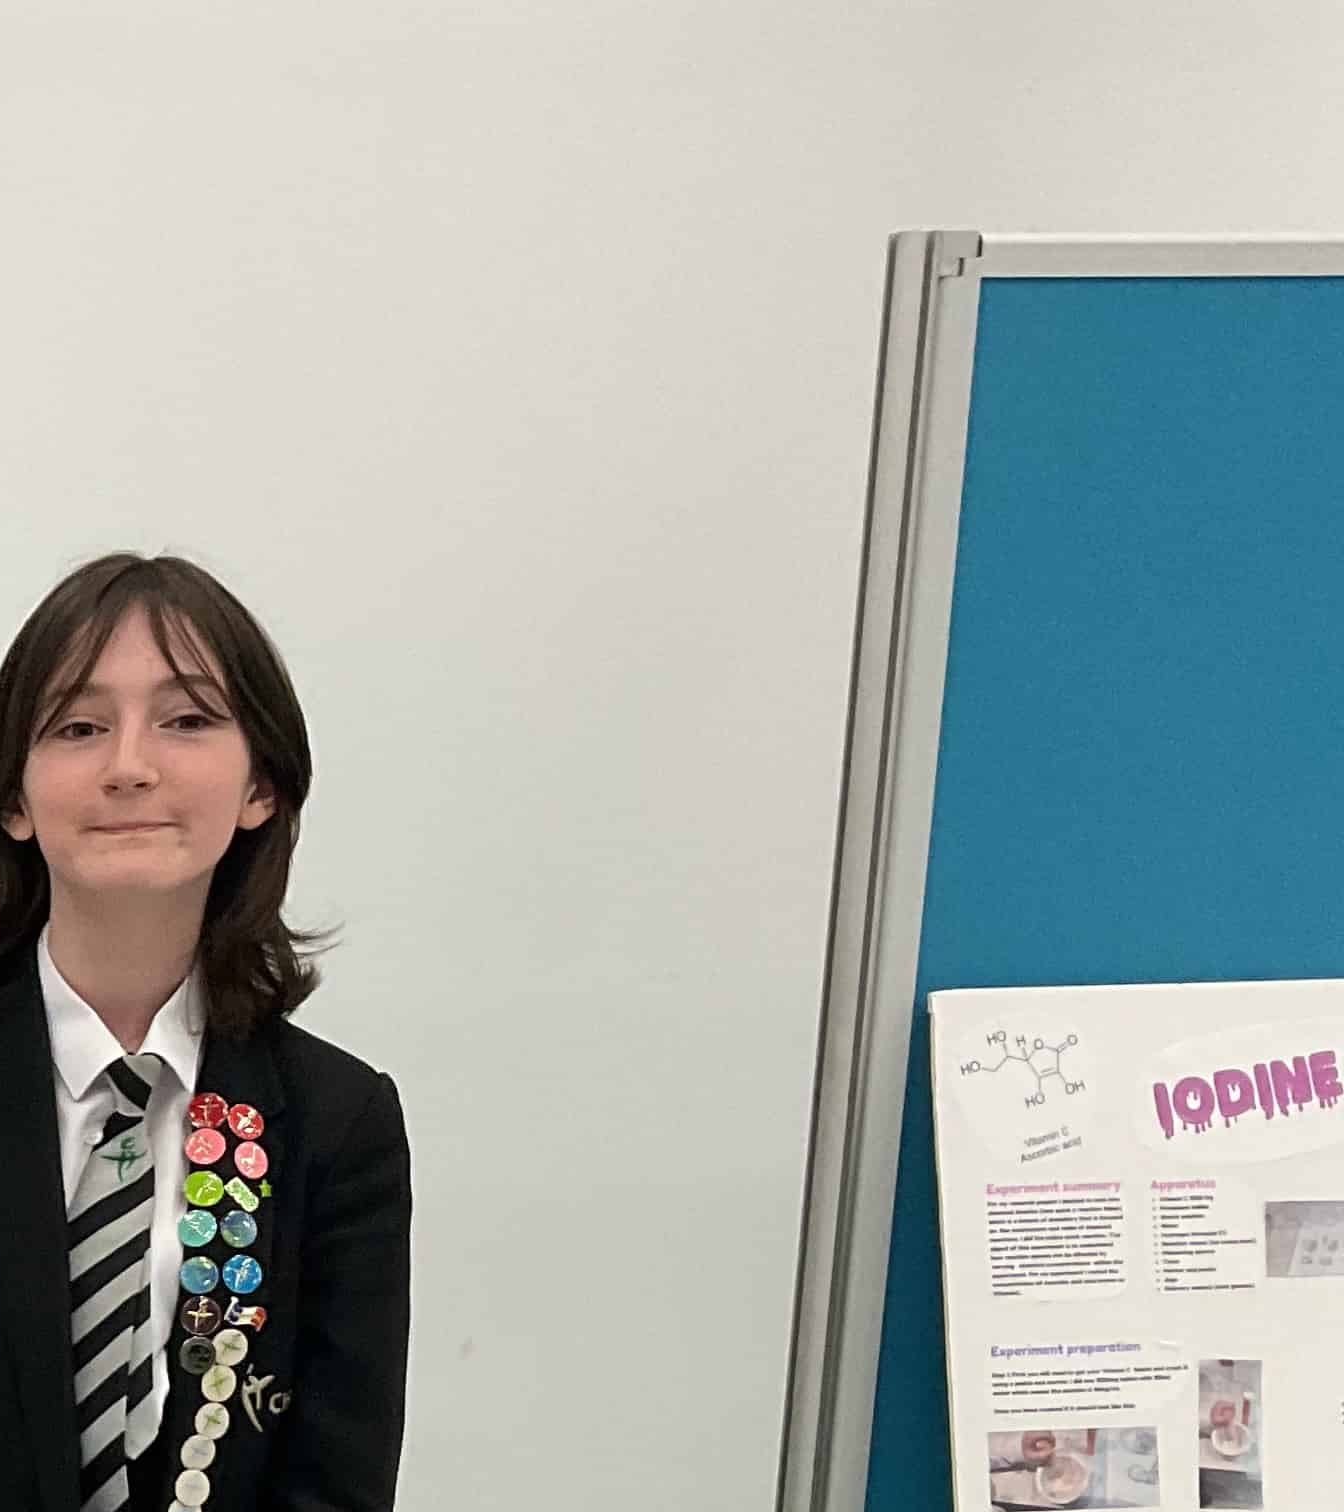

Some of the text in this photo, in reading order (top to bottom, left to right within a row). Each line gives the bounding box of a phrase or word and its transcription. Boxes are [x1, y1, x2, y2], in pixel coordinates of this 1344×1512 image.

[960, 1030, 1087, 1109] HO HO OH HO
[1153, 1050, 1343, 1139] IODINE
